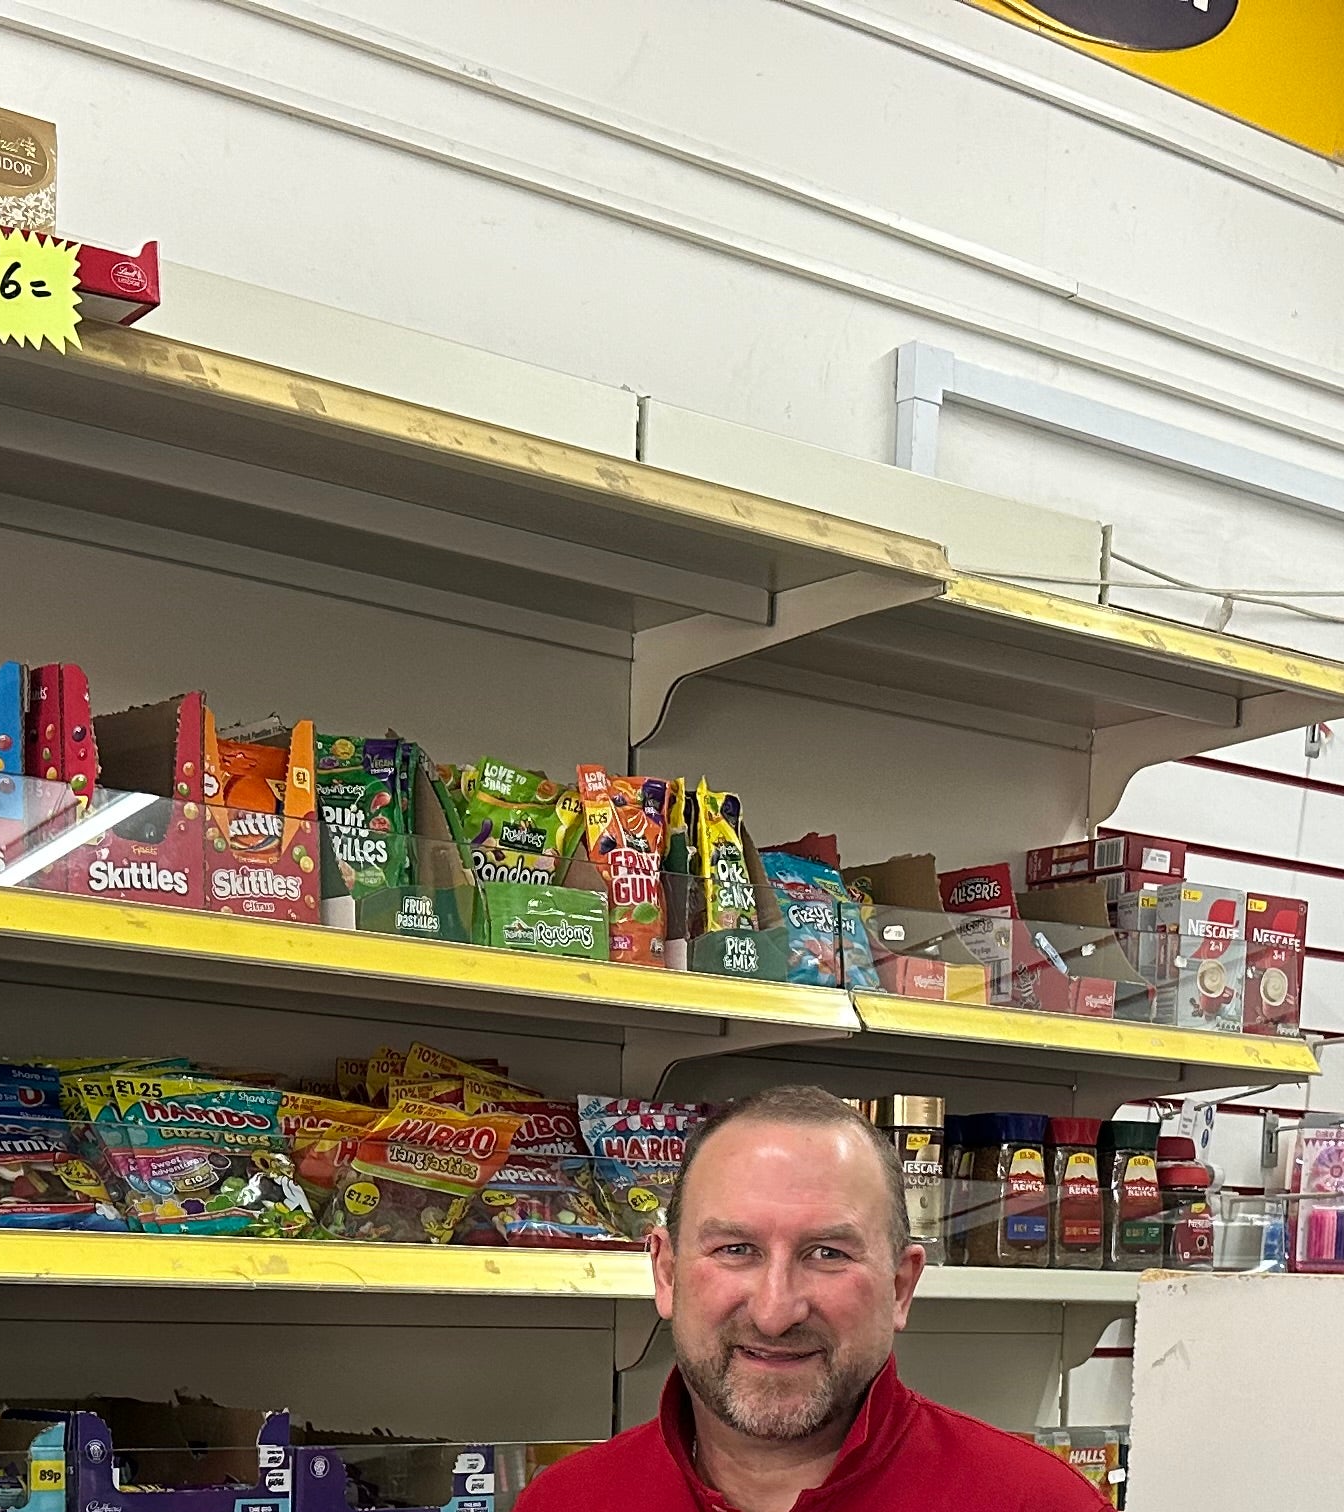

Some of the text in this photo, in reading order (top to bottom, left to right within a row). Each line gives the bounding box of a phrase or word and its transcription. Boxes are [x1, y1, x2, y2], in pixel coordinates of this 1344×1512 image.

[296, 772, 307, 783] £1
[484, 763, 527, 785] LOVE TO
[484, 777, 512, 796] SHARE
[88, 861, 189, 895] Skittles
[211, 867, 304, 899] Skittles
[950, 880, 1001, 904] ALLSORTS
[243, 900, 275, 913] Citrus
[535, 919, 594, 947] Randoms
[725, 935, 755, 956] Pick
[11, 1070, 40, 1080] Share
[115, 1079, 163, 1098] £1.25
[237, 1091, 266, 1104] Share
[141, 1100, 270, 1129] HARIBO
[581, 1098, 602, 1118] NEW
[160, 1126, 222, 1143] Buzzy
[585, 1120, 607, 1140] NEW
[151, 1157, 182, 1170] Sweet
[388, 1146, 480, 1180] Tangfastics
[346, 1190, 379, 1208] £1.25
[1069, 1449, 1106, 1464] HALLS
[39, 1469, 61, 1482] 89p
